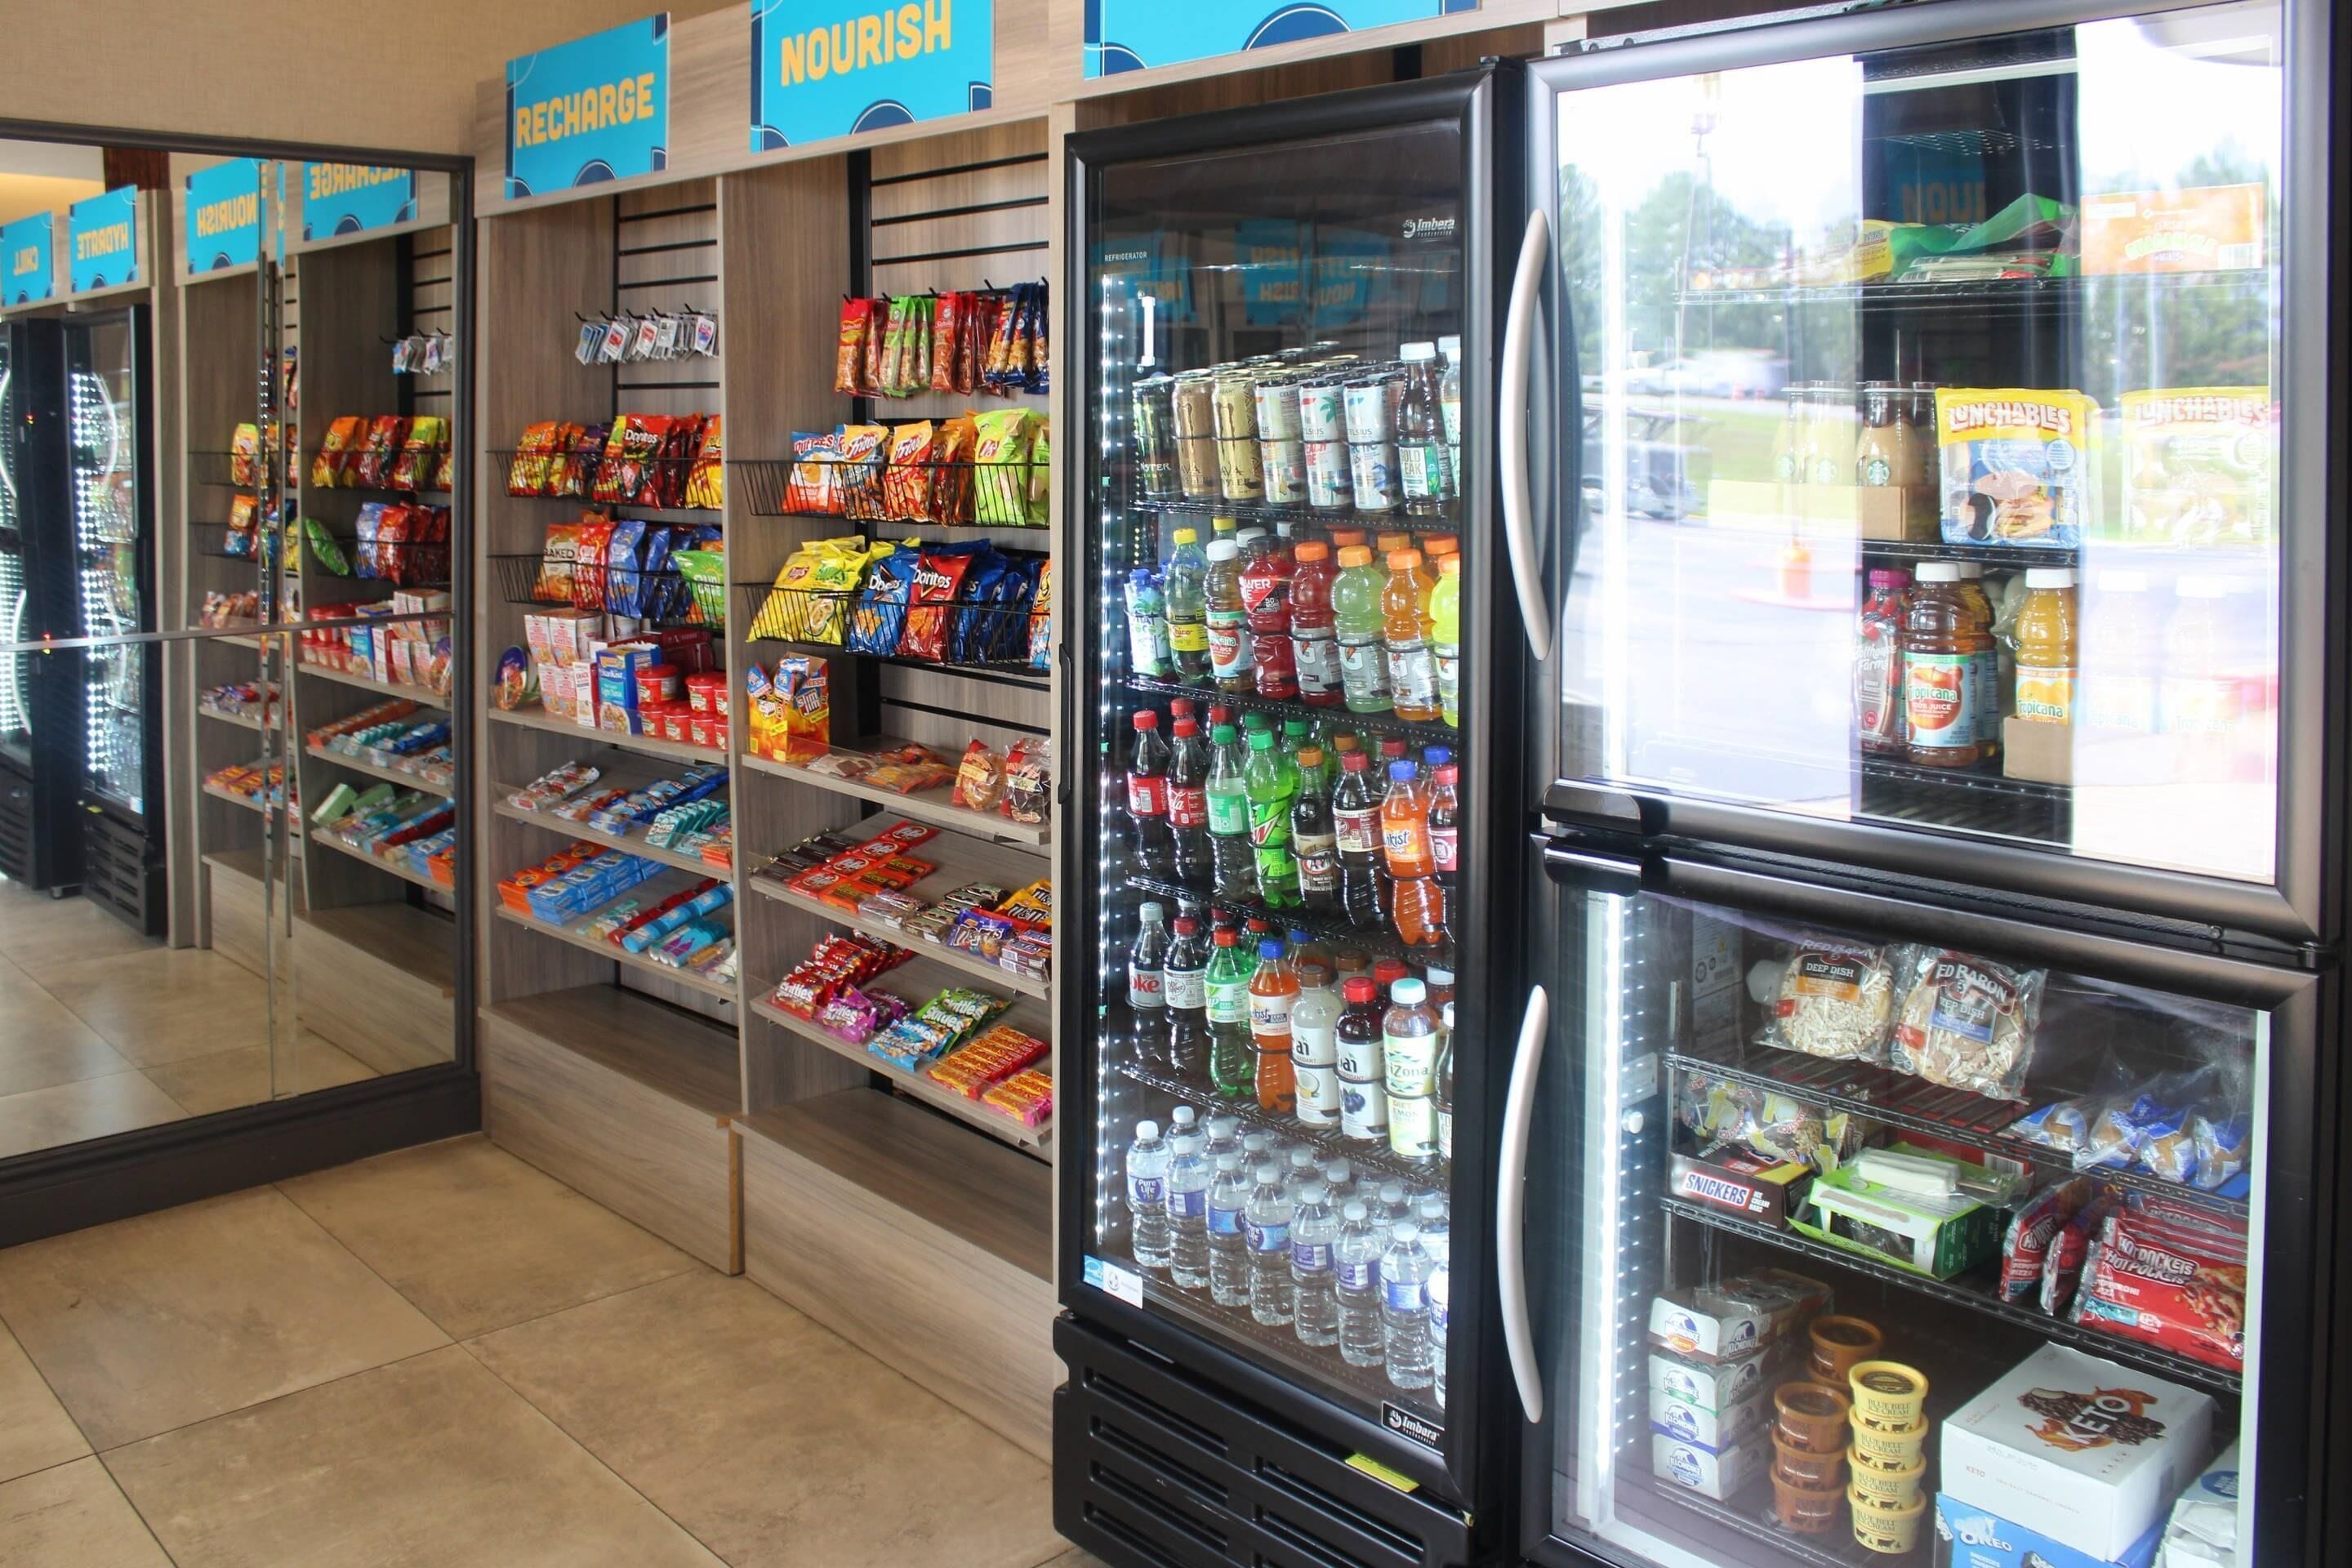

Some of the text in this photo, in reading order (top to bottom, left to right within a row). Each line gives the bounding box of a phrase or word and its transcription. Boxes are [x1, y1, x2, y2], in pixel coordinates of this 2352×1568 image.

[780, 0, 951, 86] NOURISH
[515, 73, 654, 148] RECHARGE
[1417, 217, 1455, 231] Imbera
[1104, 252, 1148, 261] REFRIGERATOR
[1949, 401, 2074, 434] LUNCHABLES
[2136, 397, 2269, 429] LUNCHABLES
[848, 433, 878, 457] Fritos
[895, 434, 922, 460] Fritos
[912, 569, 952, 590] Doritos
[1908, 684, 1958, 702] Tropicana
[1928, 702, 1952, 710] JUICE
[2017, 698, 2064, 718] Tropicana
[1800, 938, 1835, 954] RED
[1805, 961, 1855, 978] DEEP DISH
[1936, 963, 2008, 1003] ED BARON
[1960, 1004, 1986, 1020] DISH
[1138, 1178, 1157, 1187] Pure
[1140, 1185, 1156, 1197] Life
[1686, 1173, 1748, 1206] SNICKERS
[1750, 1197, 1771, 1209] CREAM
[1753, 1191, 1763, 1200] ICE
[2106, 1250, 2129, 1271] HOT
[1880, 1405, 1910, 1414] CREAM
[1401, 1414, 1438, 1442] Imbera
[2056, 1395, 2132, 1446] KETO
[1873, 1444, 1902, 1454] CREAM
[1965, 1464, 1987, 1478] KETO
[1869, 1483, 1899, 1494] CREAM
[1867, 1521, 1895, 1532] CREAM
[1959, 1528, 2013, 1552] OREO
